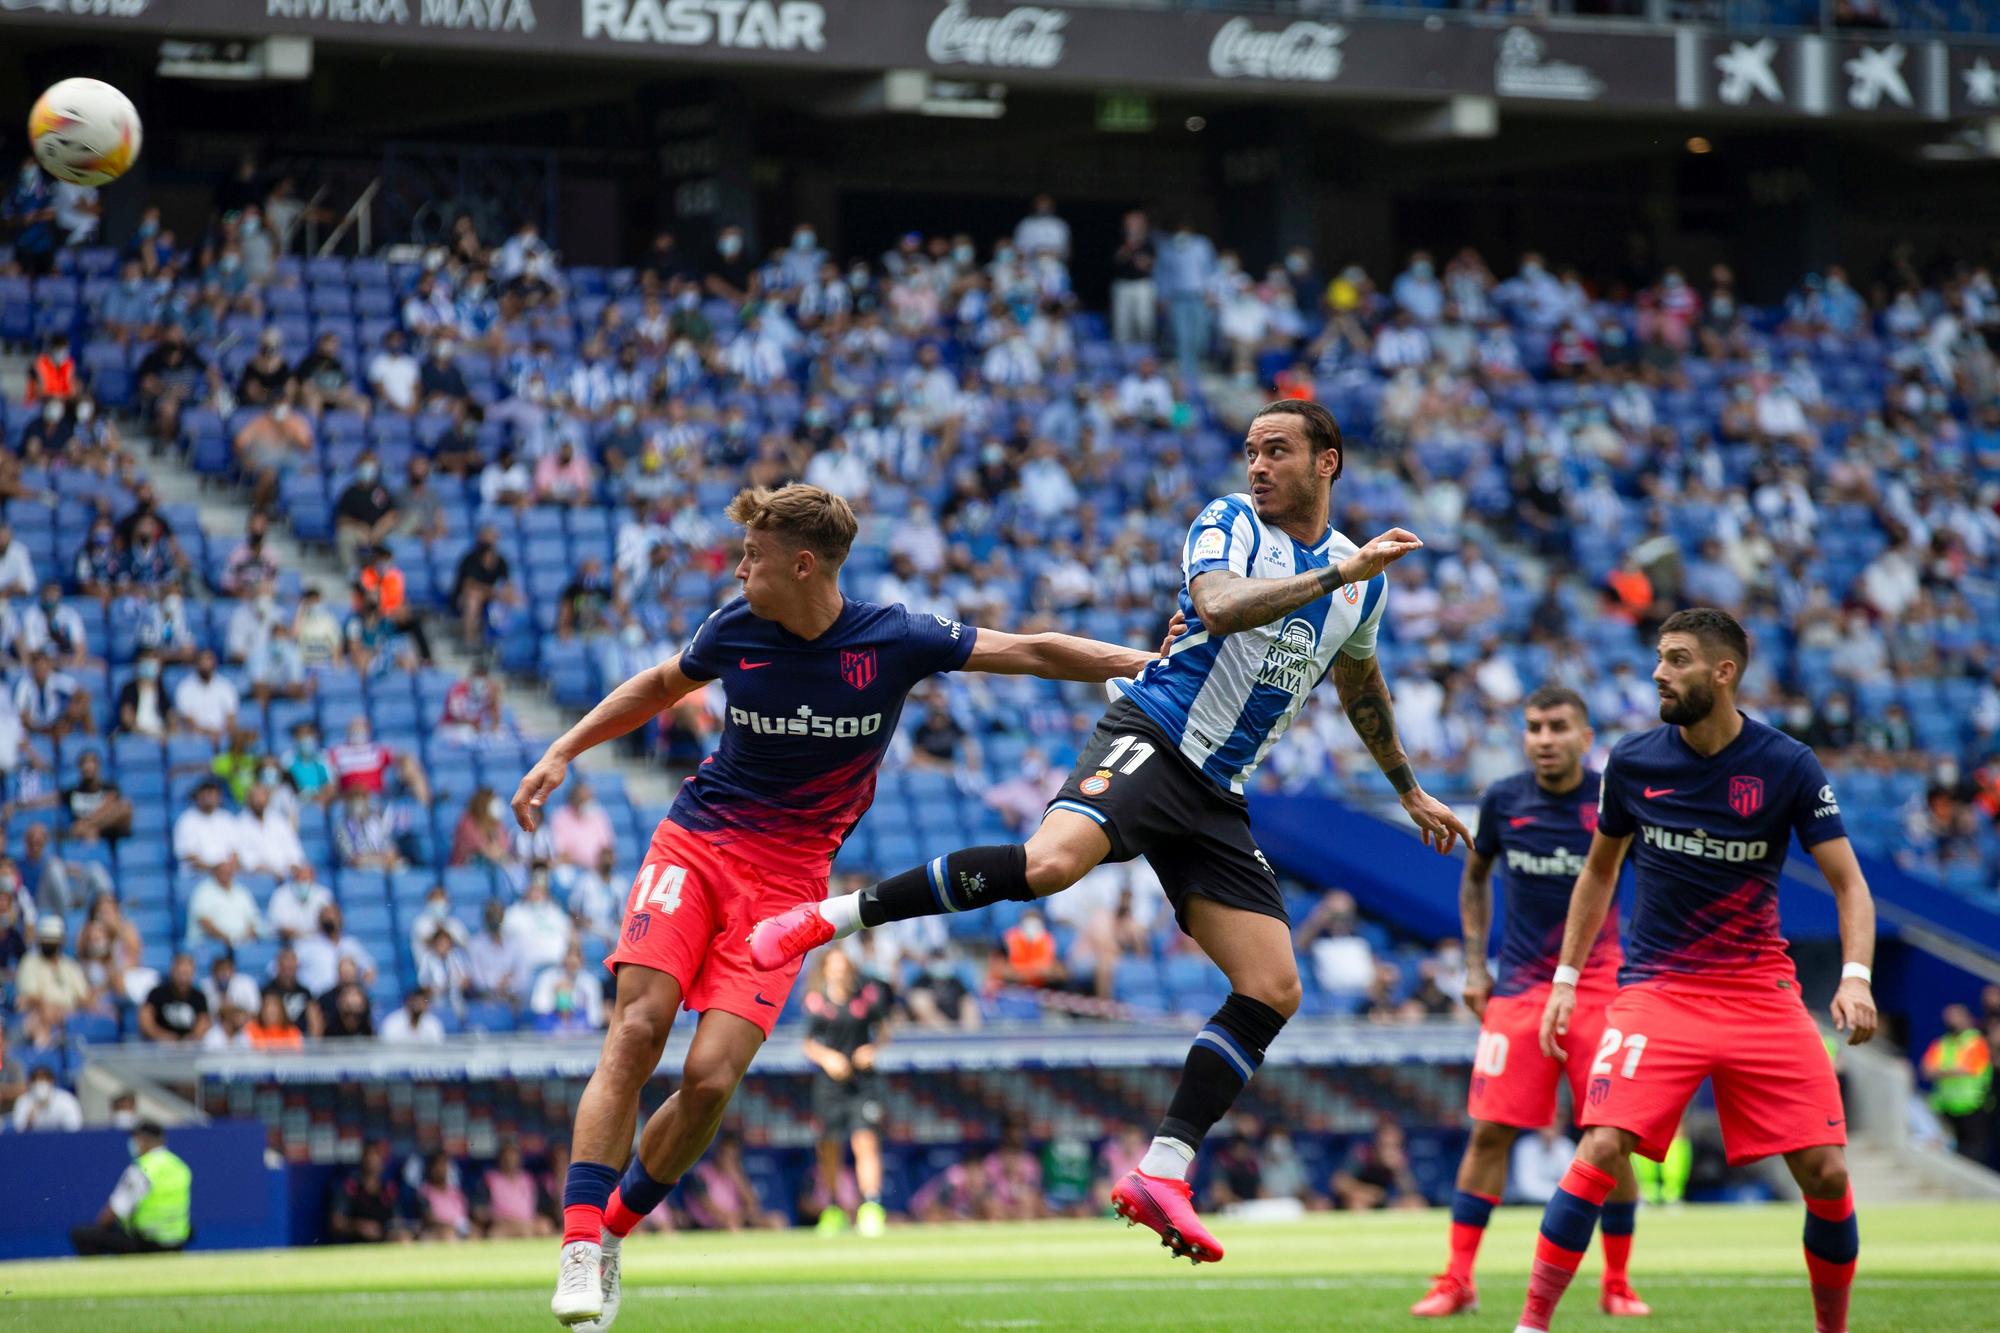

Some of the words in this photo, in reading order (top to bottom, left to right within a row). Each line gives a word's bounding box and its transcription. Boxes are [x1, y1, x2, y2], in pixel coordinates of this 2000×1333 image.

[582, 0, 827, 50] RASTAR
[926, 0, 1069, 68] Coca-Cola
[1208, 16, 1347, 81] Coca-Cola
[1264, 556, 1288, 568] KELME
[1257, 659, 1302, 694] MAYA
[1265, 645, 1309, 675] RIVIERA
[730, 704, 882, 738] Plus500
[1099, 735, 1156, 776] 11
[1641, 825, 1768, 862] Plus500
[633, 863, 688, 916] 14
[1592, 1027, 1648, 1080] 21
